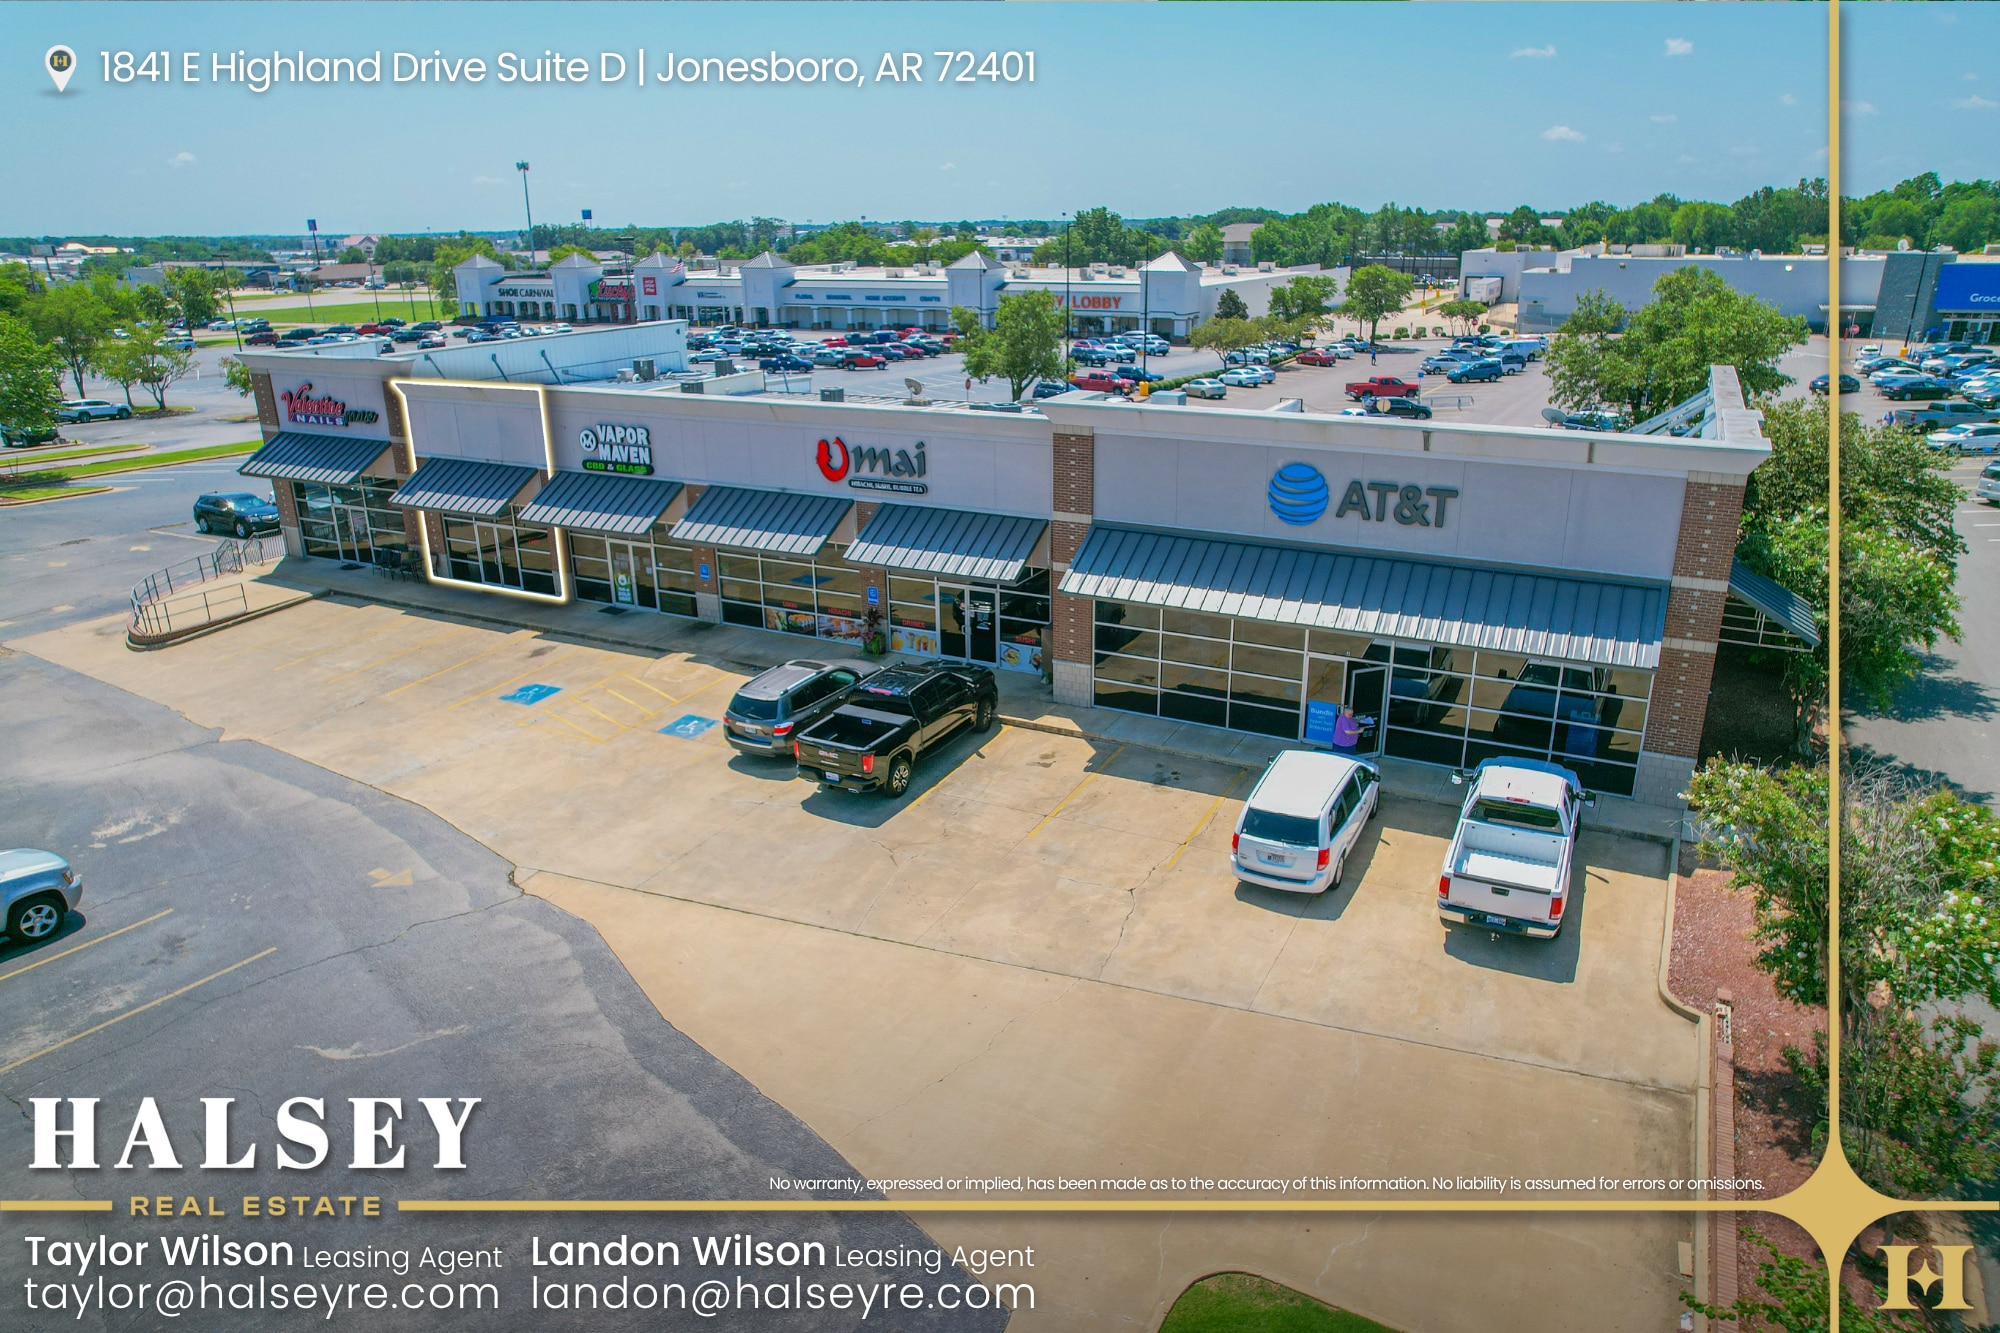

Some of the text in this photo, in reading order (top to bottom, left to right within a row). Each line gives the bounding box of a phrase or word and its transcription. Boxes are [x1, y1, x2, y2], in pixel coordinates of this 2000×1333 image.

[498, 288, 518, 297] SHOE
[1072, 295, 1121, 309] LOBBY
[281, 383, 344, 421] Valentine
[296, 413, 344, 426] NAILS
[596, 425, 650, 446] VAPOR
[598, 443, 652, 465] MAVEN
[816, 436, 927, 482] Umai
[586, 461, 648, 474] CBD & GLASS
[912, 486, 924, 494] TEA
[1335, 481, 1459, 528] AT&T
[827, 607, 852, 617] HIBACHI
[902, 619, 926, 629] DRINKS
[1015, 635, 1037, 645] SUSHI
[1310, 707, 1334, 717] Bundle
